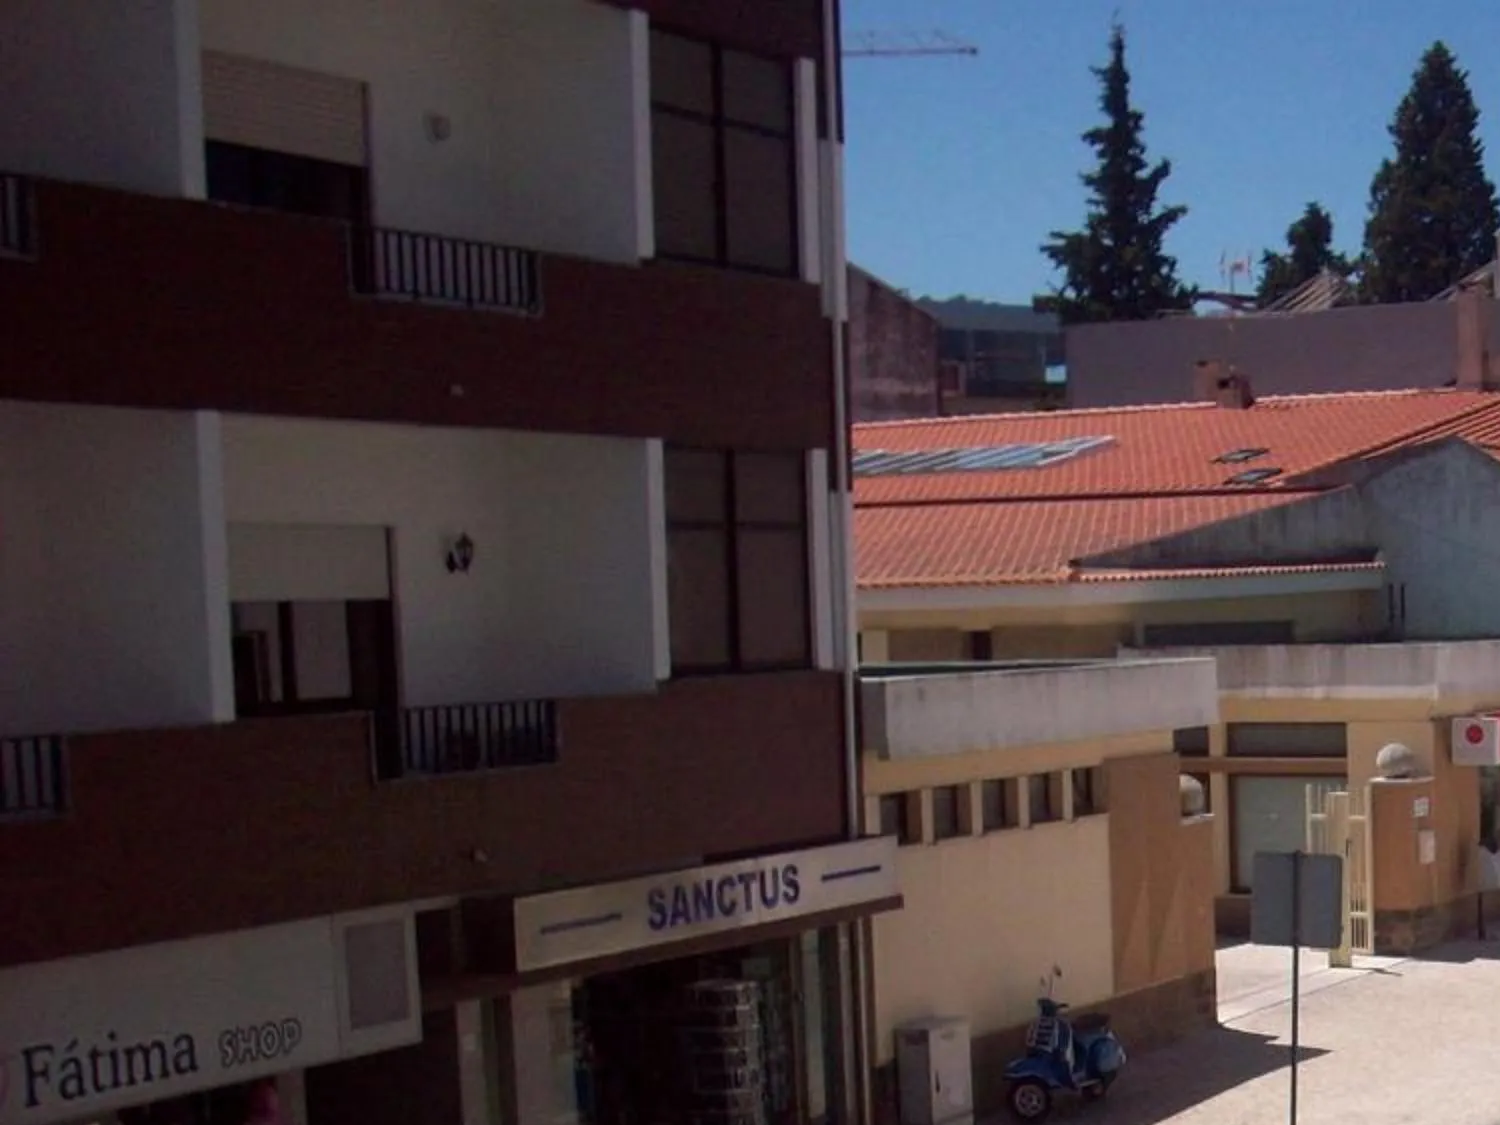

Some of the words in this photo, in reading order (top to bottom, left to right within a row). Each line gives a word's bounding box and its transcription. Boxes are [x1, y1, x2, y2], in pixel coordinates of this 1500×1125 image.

[647, 863, 800, 931] SANCTUS
[21, 1030, 199, 1109] Fátima
[217, 1017, 302, 1069] SHOP
